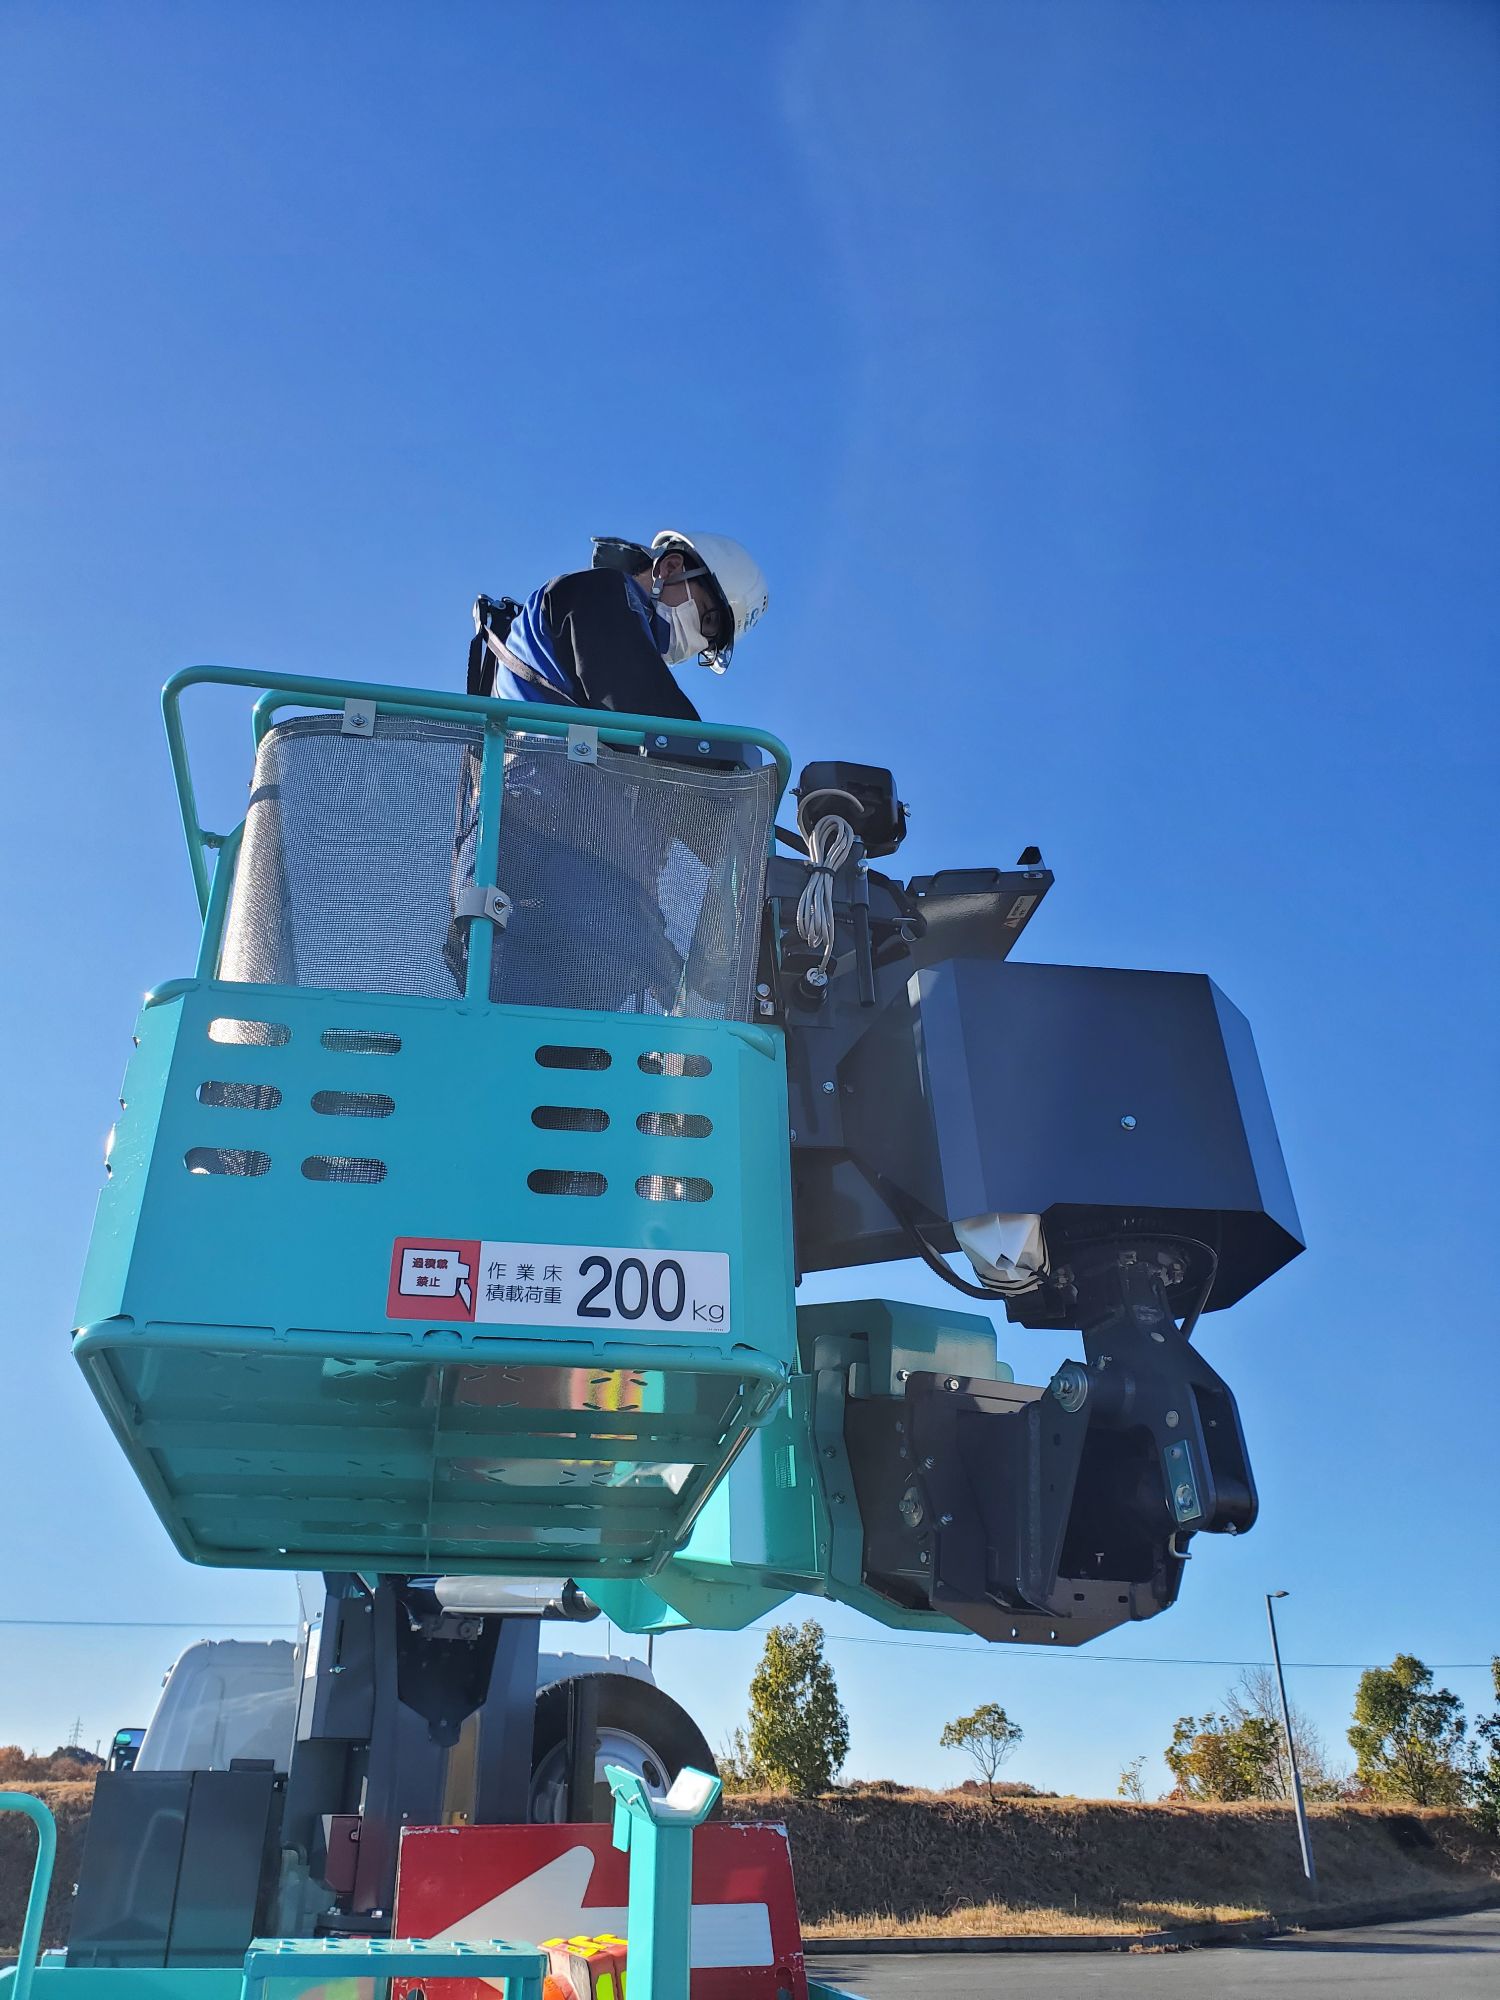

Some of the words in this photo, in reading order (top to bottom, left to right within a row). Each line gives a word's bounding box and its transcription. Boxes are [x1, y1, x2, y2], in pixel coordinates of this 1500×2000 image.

[415, 1275, 441, 1288] 禁止
[487, 1261, 563, 1282] 作業床
[485, 1283, 563, 1305] 積載荷重
